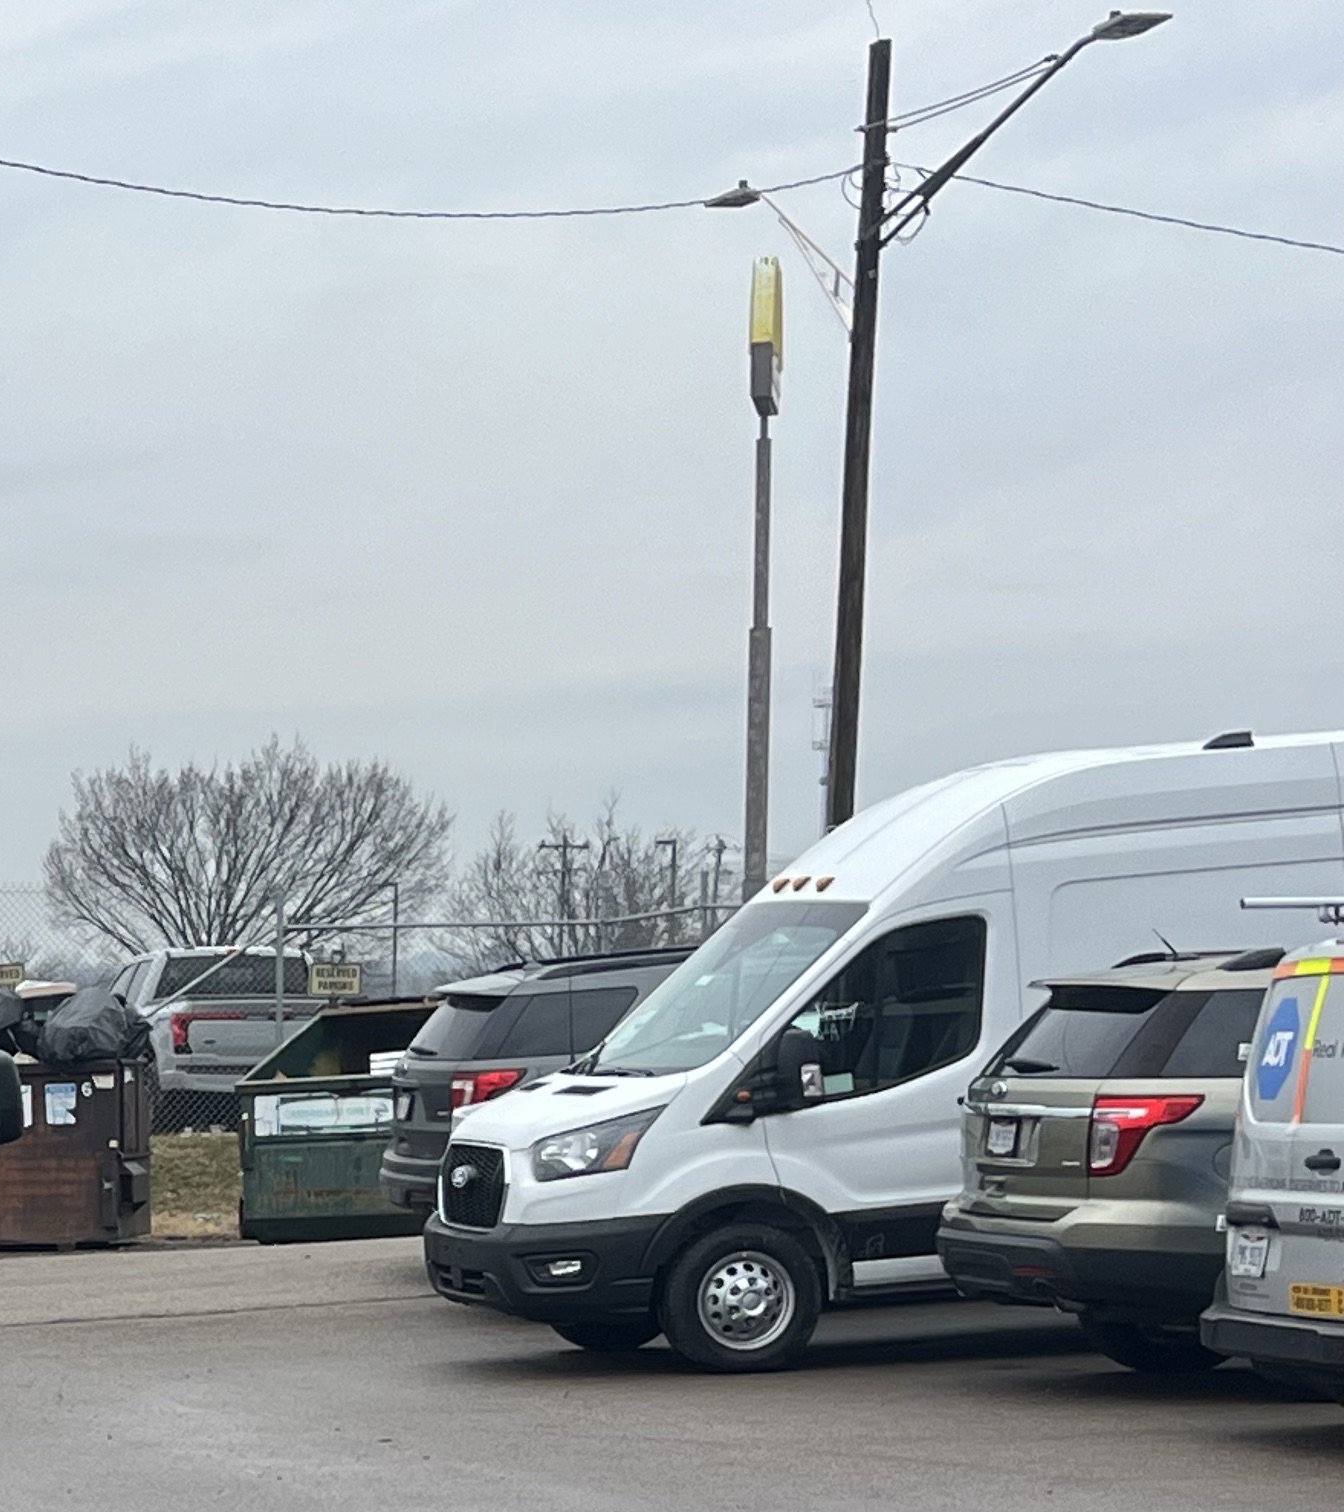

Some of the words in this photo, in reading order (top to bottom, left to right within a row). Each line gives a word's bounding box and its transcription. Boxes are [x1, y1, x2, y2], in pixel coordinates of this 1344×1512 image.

[316, 967, 358, 978] RESERVED
[318, 981, 354, 991] PARKING
[1260, 1030, 1295, 1067] ADT
[80, 1081, 93, 1097] 6
